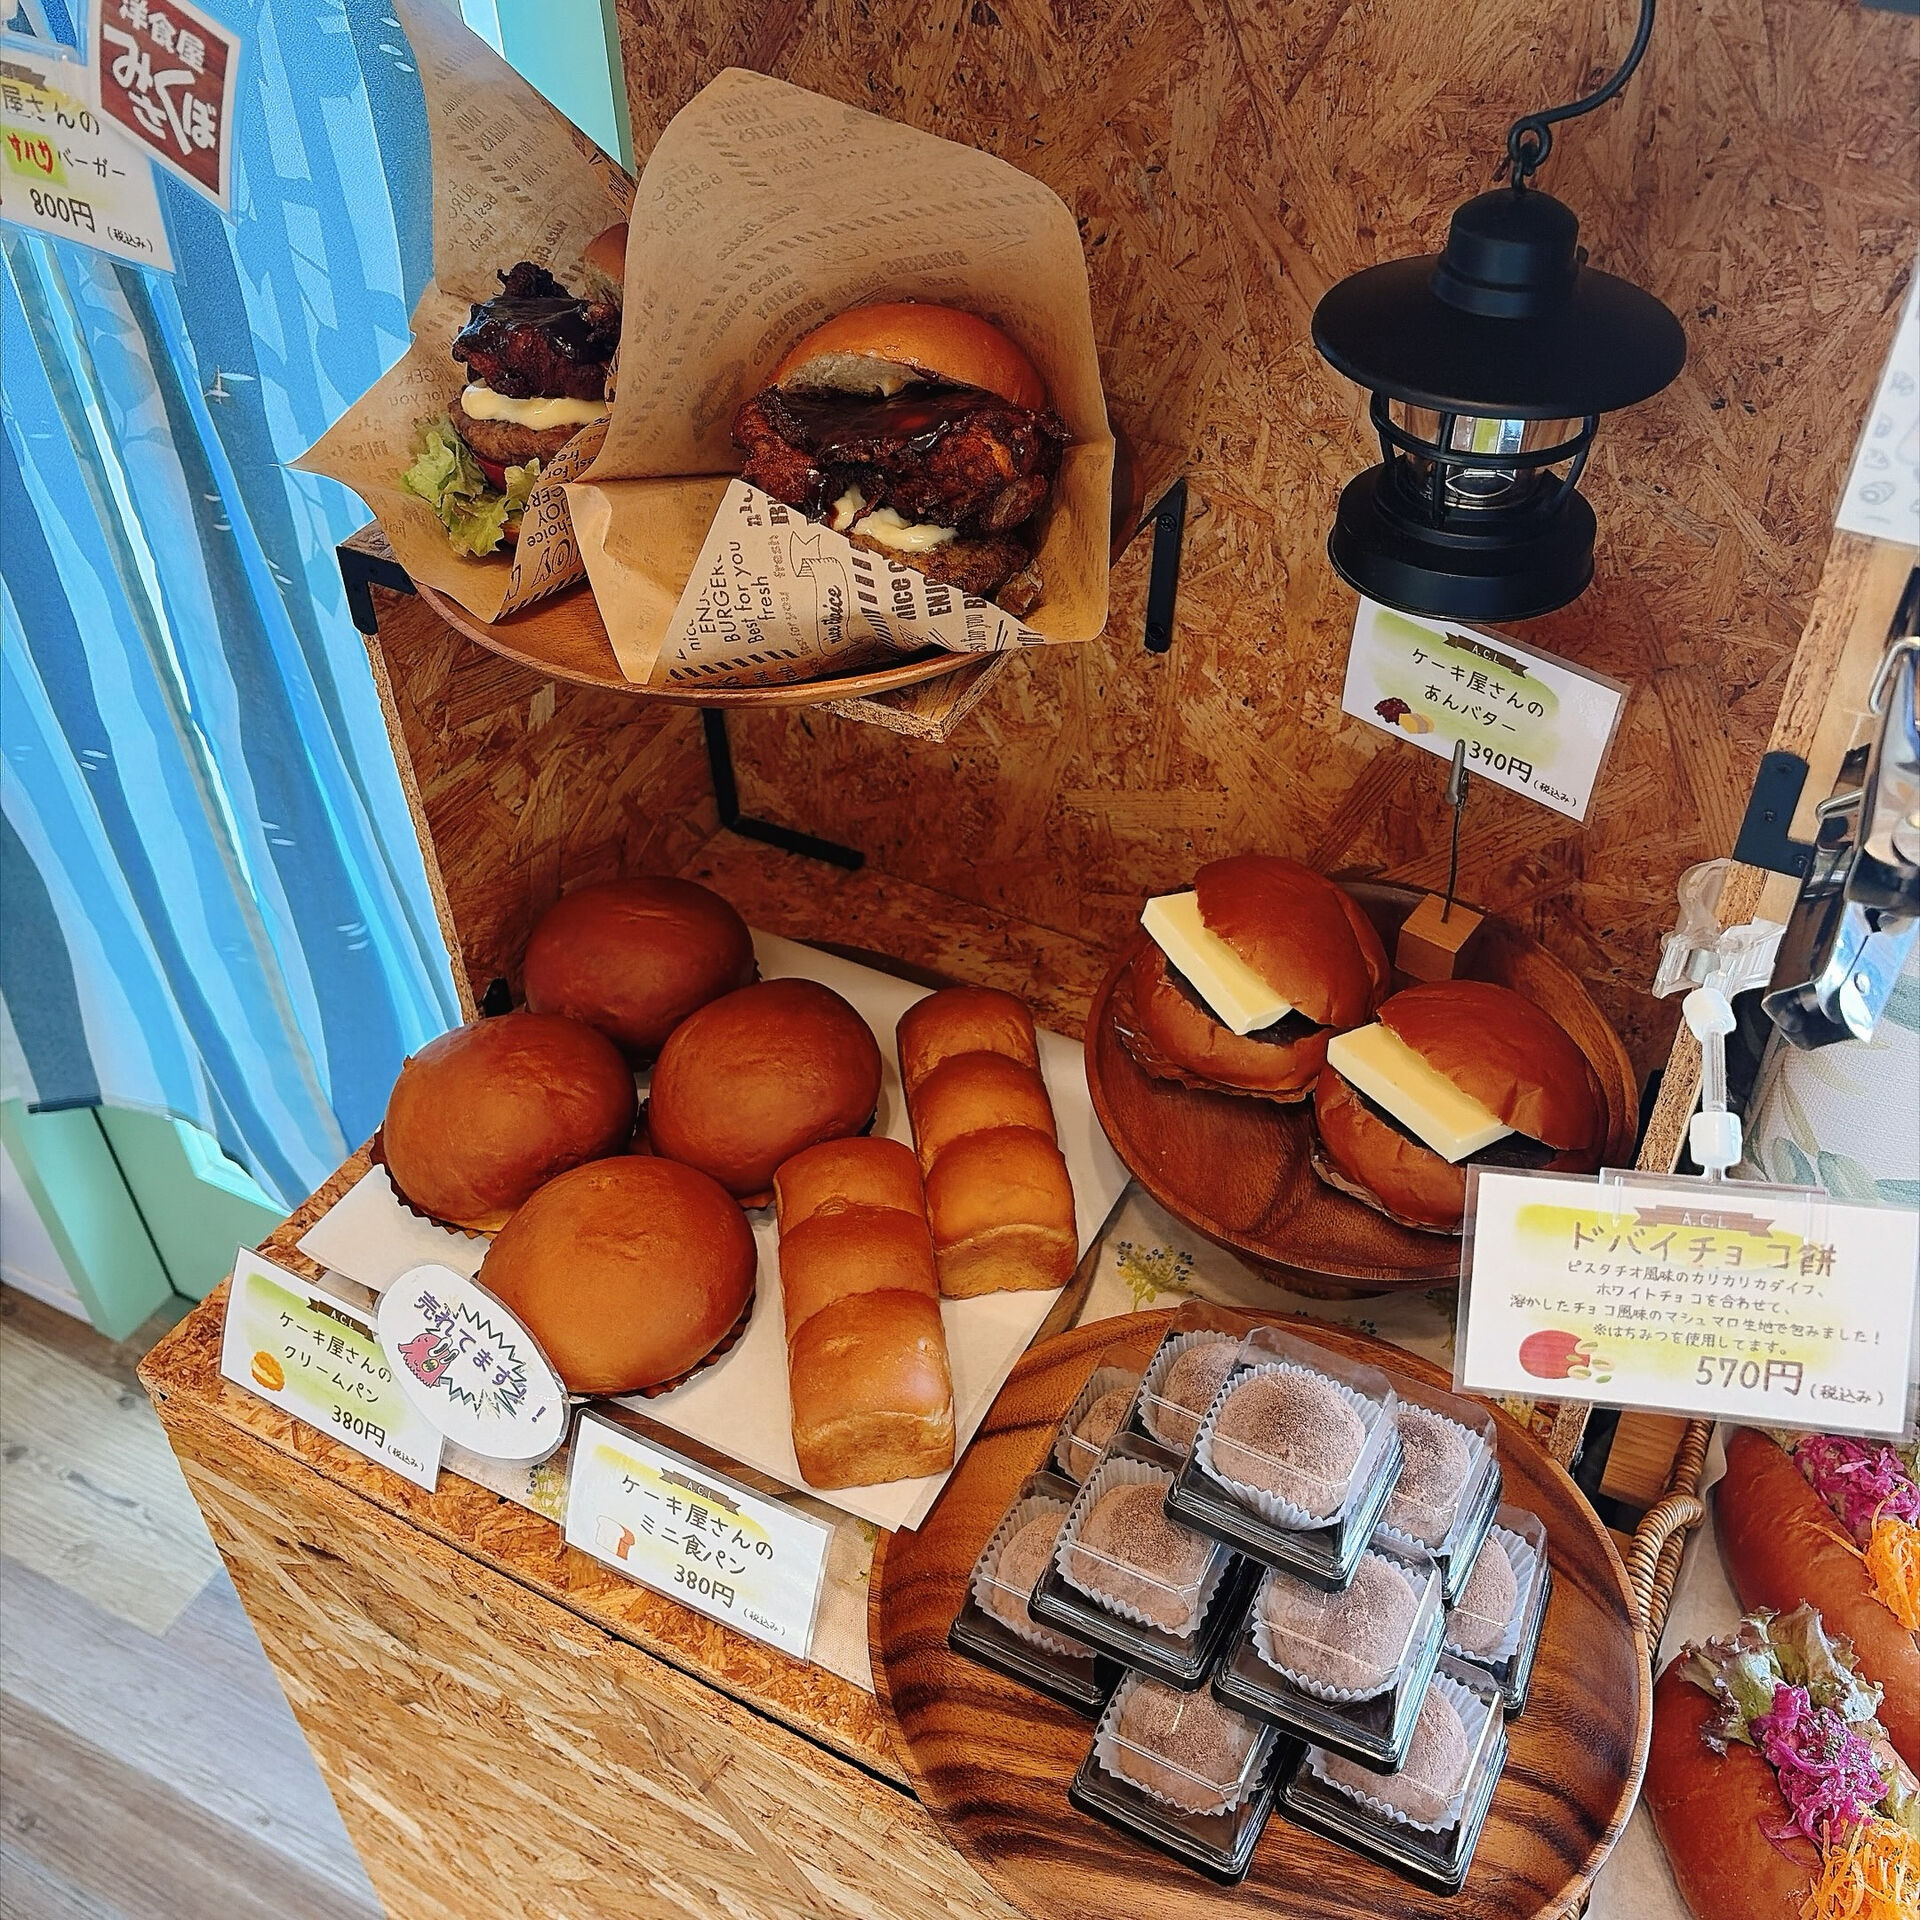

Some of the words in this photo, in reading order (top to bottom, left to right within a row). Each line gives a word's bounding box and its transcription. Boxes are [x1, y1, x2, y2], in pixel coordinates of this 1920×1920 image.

[119, 0, 206, 74] 洋食屋
[29, 188, 96, 233] 800円
[729, 541, 752, 577] you
[734, 584, 753, 612] for
[751, 575, 777, 621] fresh
[741, 617, 765, 644] Best
[1411, 647, 1545, 717] ケーキ屋さんの
[1423, 683, 1517, 734] あんバター
[1468, 740, 1533, 784] 390円
[1571, 1221, 1837, 1279] ドバイチョコ餅
[1596, 1282, 1791, 1316] ホワイトチョコを合わせて、
[279, 1310, 393, 1384] ケーキ屋さんの
[283, 1344, 381, 1405] クリームパン
[1695, 1356, 1804, 1397] 570円
[330, 1404, 387, 1450] 380円
[621, 1473, 776, 1561] ケーキ屋さんの
[639, 1513, 748, 1576] ミニ食パン
[673, 1563, 737, 1609] 380円
